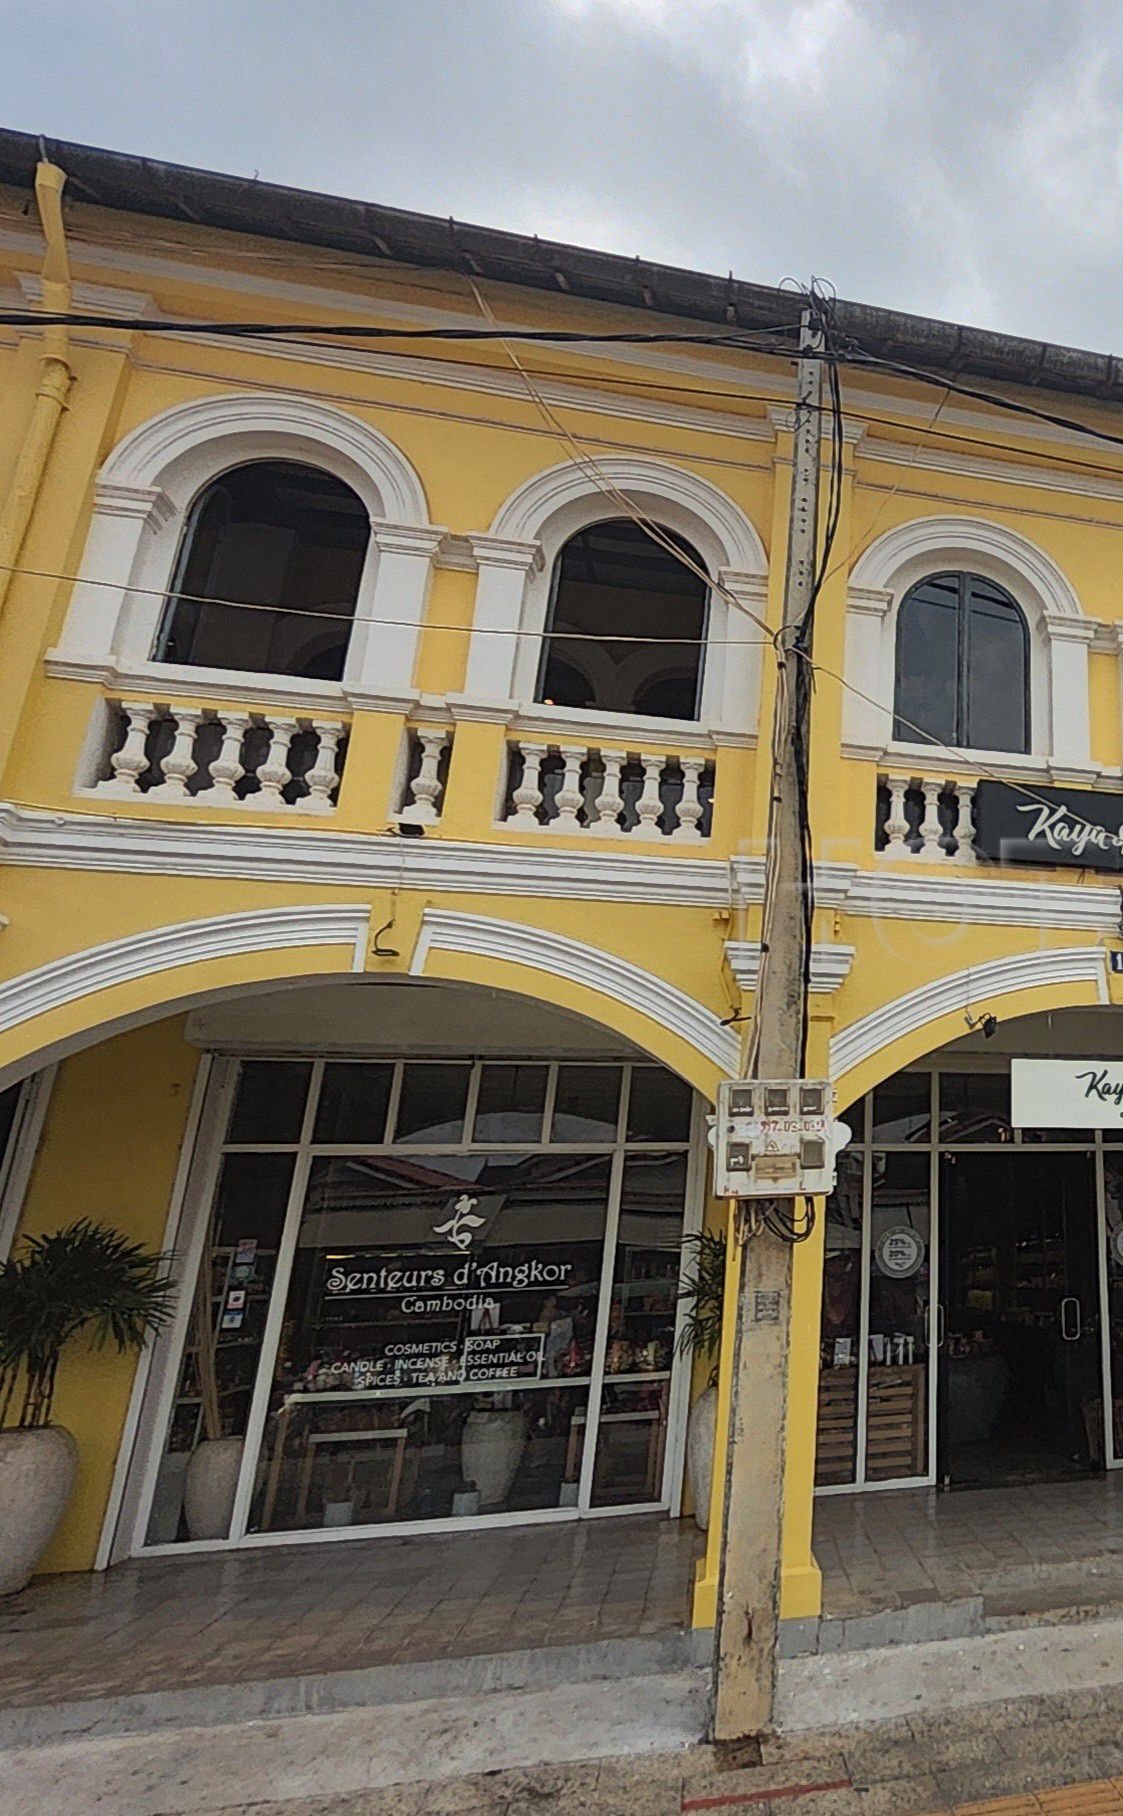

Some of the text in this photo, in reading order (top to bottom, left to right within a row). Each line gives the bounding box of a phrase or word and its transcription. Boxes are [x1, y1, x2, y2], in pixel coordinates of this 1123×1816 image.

[1016, 804, 1110, 857] Kaya
[327, 1267, 445, 1293] Senteurs
[401, 1295, 496, 1313] Cambodia
[384, 1339, 502, 1356] COSMETICS SOAP
[331, 1359, 386, 1374] CANDLE
[394, 1355, 450, 1370] INCENSE
[356, 1372, 401, 1390] SPICES
[410, 1371, 435, 1384] TEA
[469, 1365, 519, 1380] COFFEE
